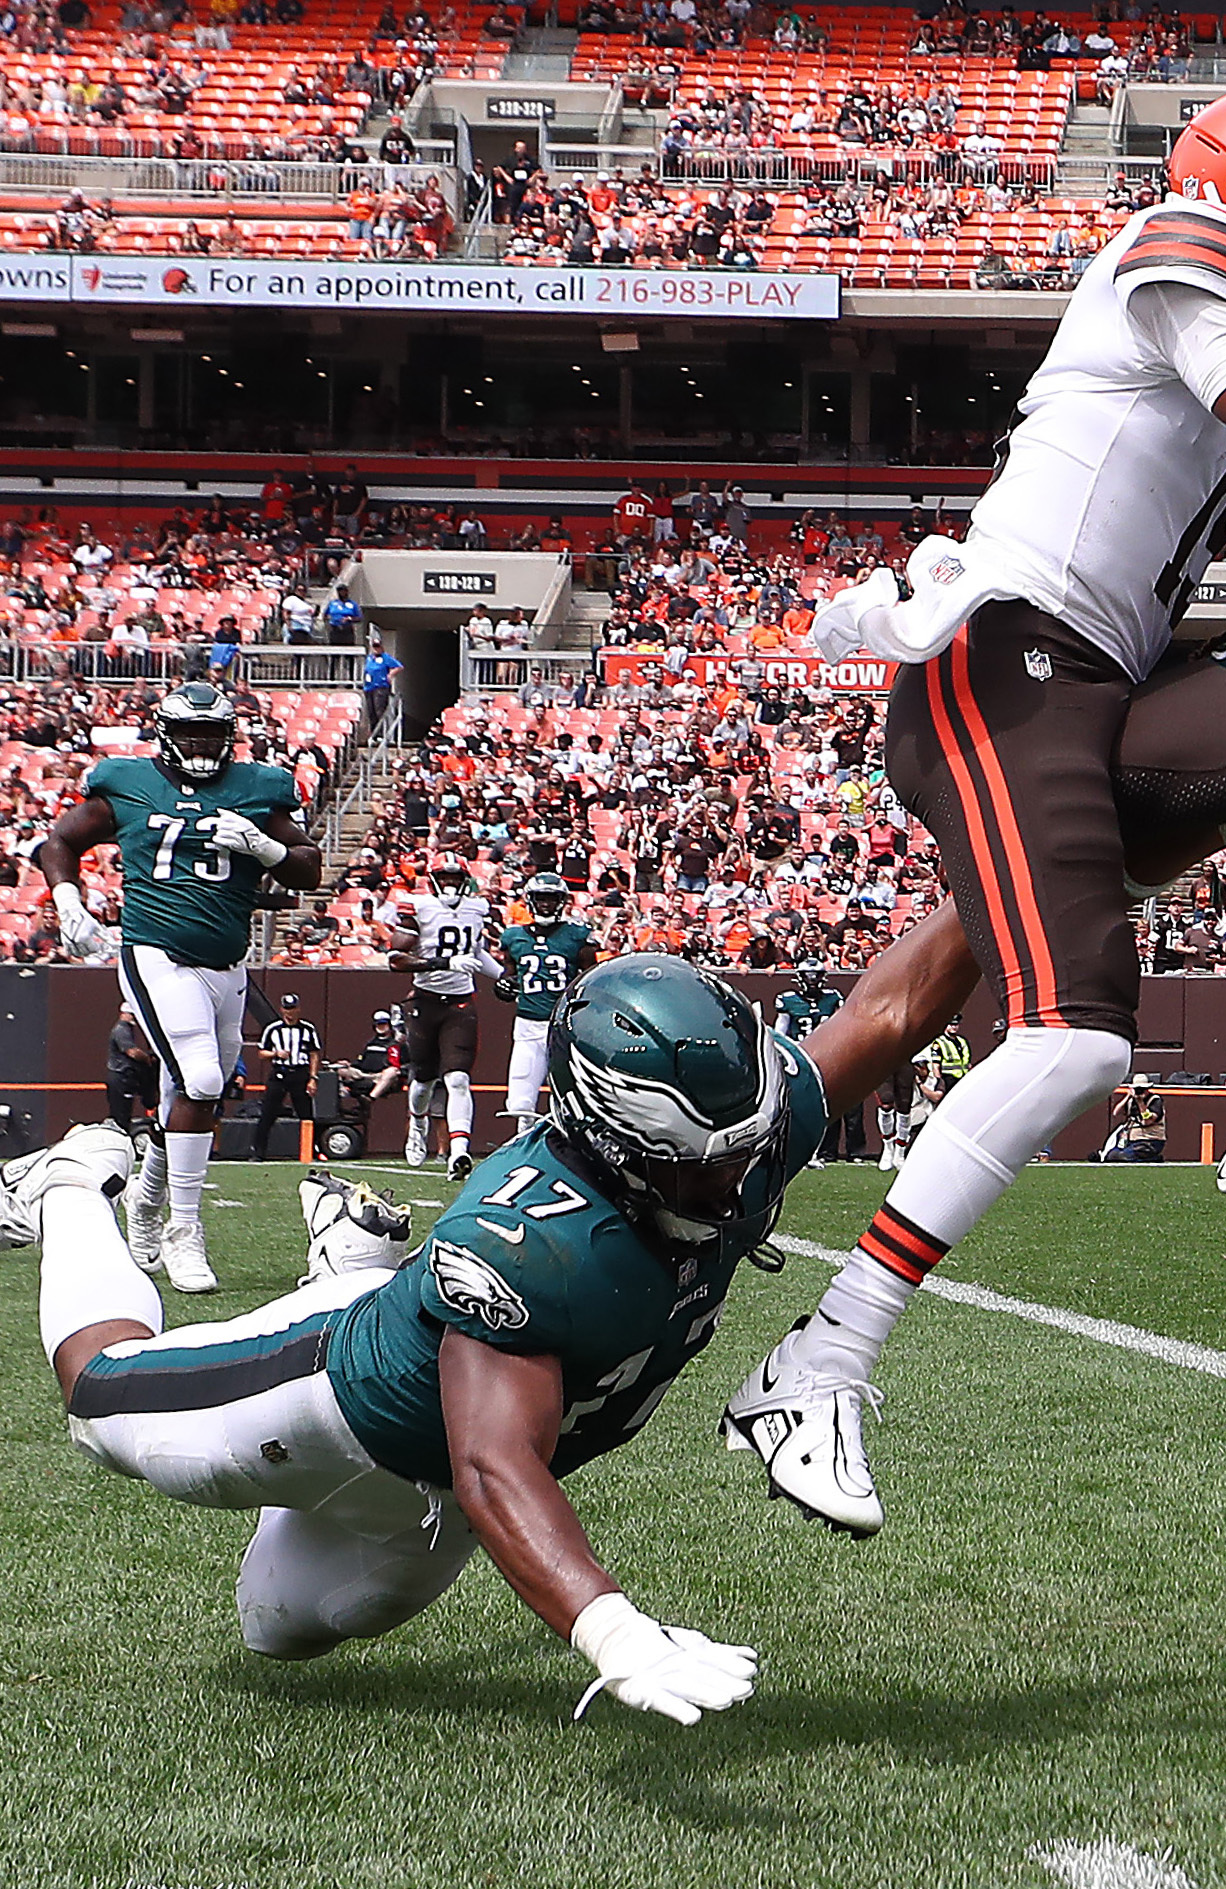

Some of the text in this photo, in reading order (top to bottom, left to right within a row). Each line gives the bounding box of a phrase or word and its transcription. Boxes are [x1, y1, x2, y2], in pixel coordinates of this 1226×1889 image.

[209, 268, 803, 306] For an appointment, call 216-983-PLAY
[624, 502, 646, 517] 00
[818, 662, 887, 687] ROW
[147, 813, 232, 882] 73
[437, 925, 472, 961] 81
[521, 954, 568, 992] 23
[481, 1165, 592, 1219] 17
